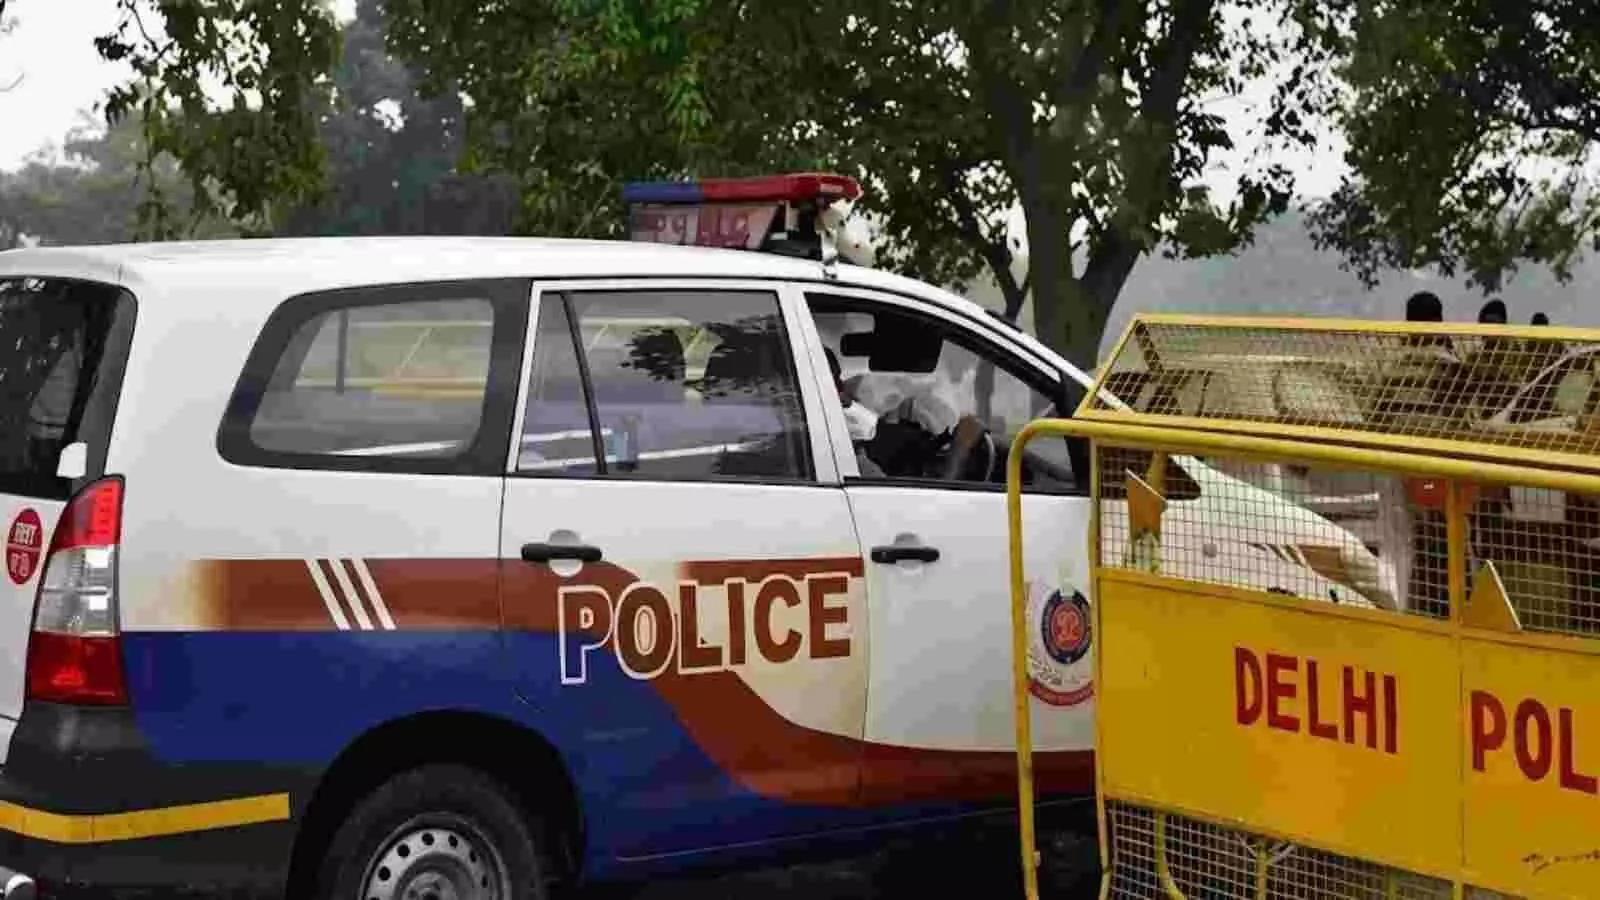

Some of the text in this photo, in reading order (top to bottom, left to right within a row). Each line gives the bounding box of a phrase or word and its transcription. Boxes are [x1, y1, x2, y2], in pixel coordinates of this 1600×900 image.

[557, 572, 851, 684] POLICE
[1234, 646, 1599, 795] DELHI POL
